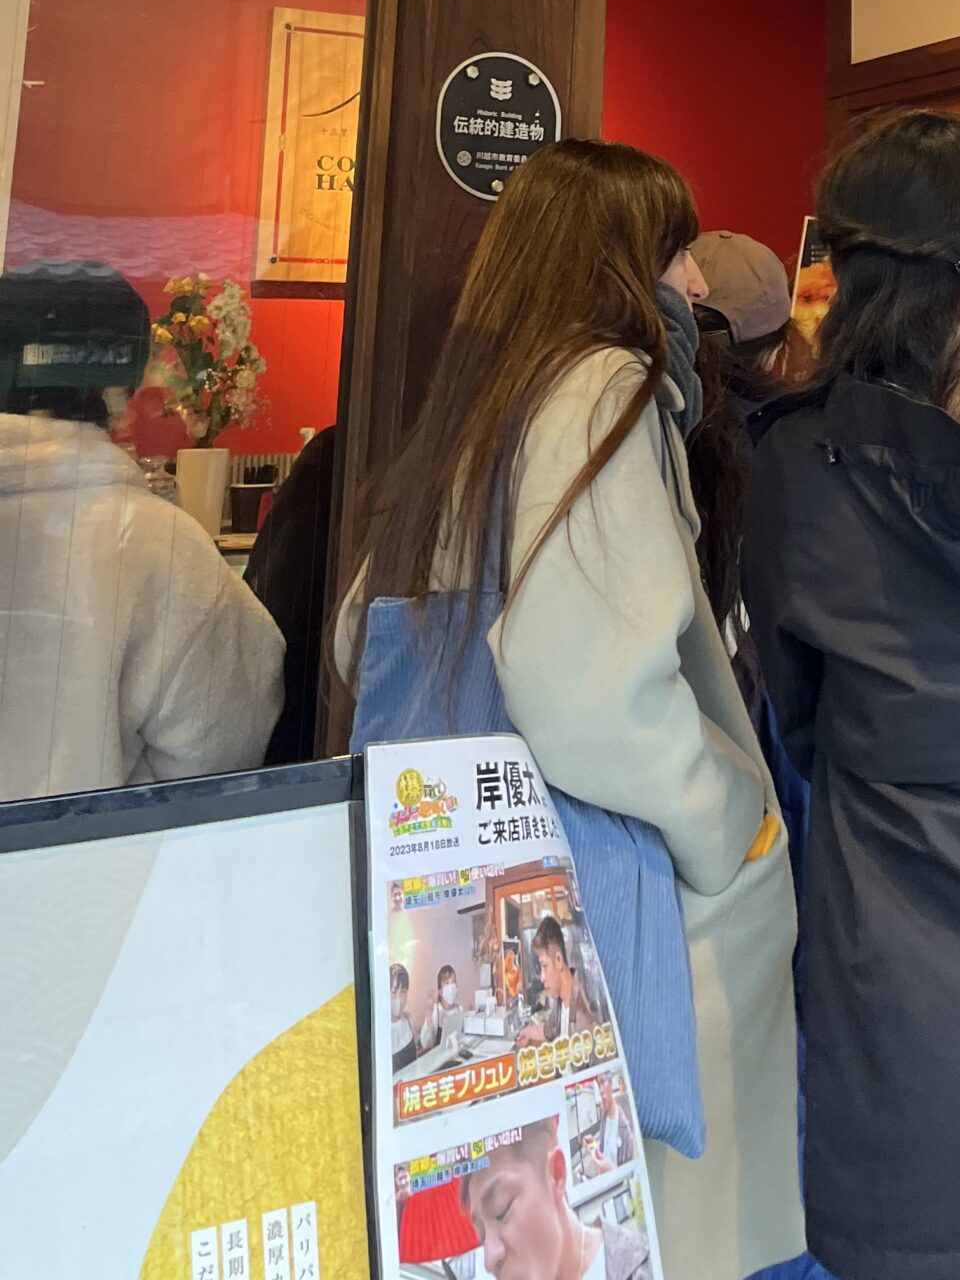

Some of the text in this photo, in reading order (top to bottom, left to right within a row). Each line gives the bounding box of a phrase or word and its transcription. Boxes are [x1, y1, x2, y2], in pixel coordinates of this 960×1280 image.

[453, 115, 545, 142] 伝統的建造物
[389, 836, 460, 857] 2023年8月18日放送
[403, 1062, 513, 1113] 焼き芋ブリュレ
[227, 1230, 245, 1276] 長期
